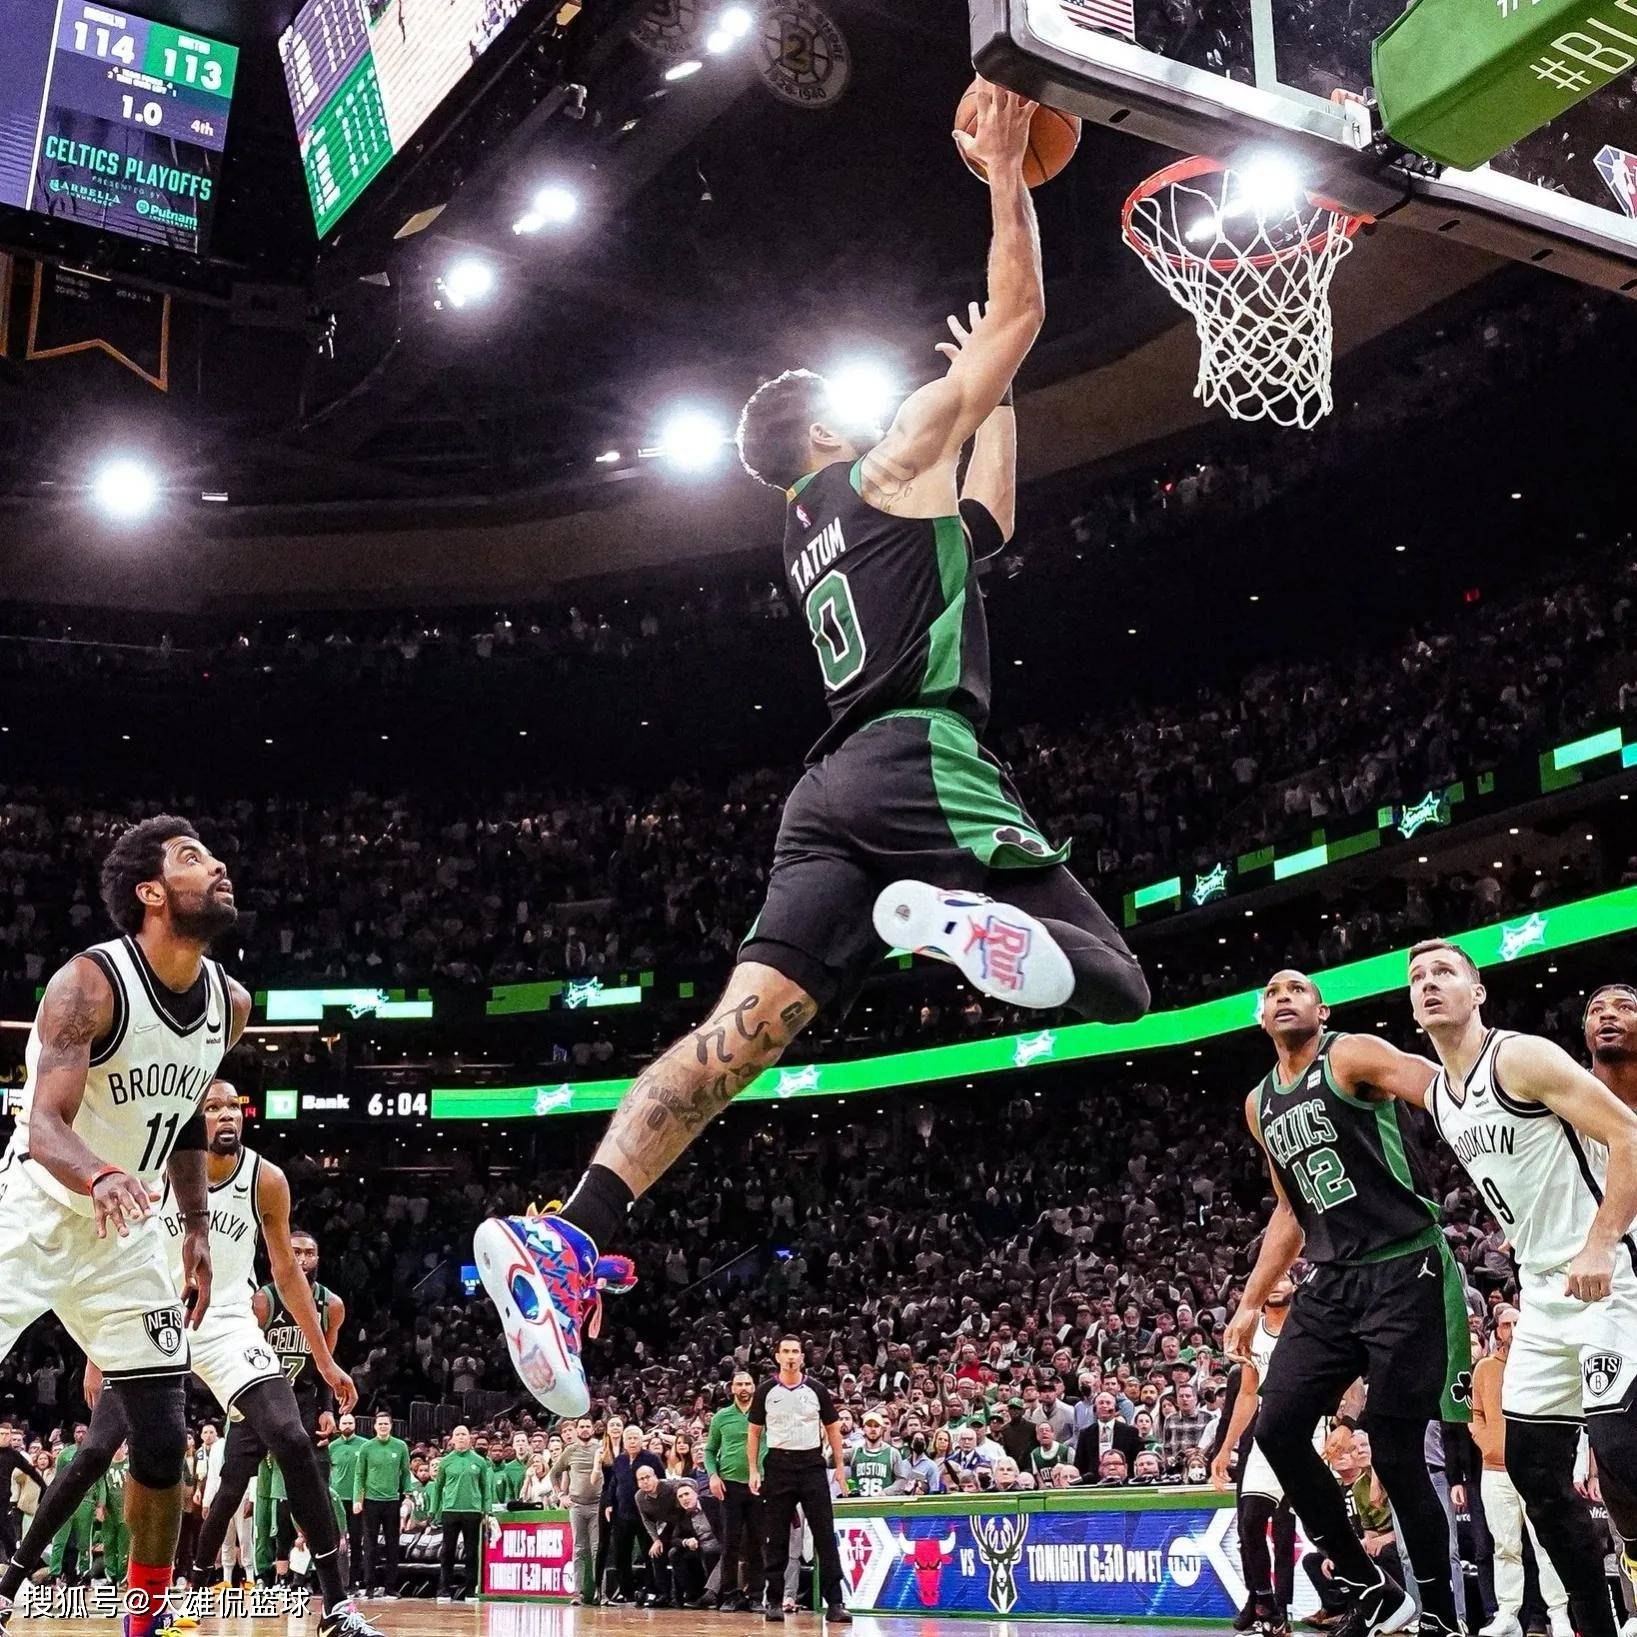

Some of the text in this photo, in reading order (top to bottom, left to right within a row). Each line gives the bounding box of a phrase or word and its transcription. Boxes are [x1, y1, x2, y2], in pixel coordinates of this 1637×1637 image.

[74, 21, 135, 64] 114
[164, 48, 222, 90] 113
[122, 95, 163, 126] 1.0
[190, 119, 214, 137] 4th
[45, 135, 212, 200] CELTICS PLAYOFFS
[150, 204, 197, 227] Putnam
[791, 517, 846, 594] TATUM
[806, 569, 867, 691] 0
[107, 1063, 211, 1105] BROOKLY
[302, 1094, 350, 1109] Bank
[368, 1093, 428, 1116] 6:04
[138, 1113, 180, 1171] 11
[1264, 1098, 1338, 1169] CELTICS
[1454, 1124, 1515, 1170] ROOKLYN
[1291, 1147, 1358, 1214] 42
[1482, 1177, 1515, 1225] 9
[164, 1210, 249, 1242] BKLYN
[147, 1310, 182, 1332] NETS
[165, 1331, 173, 1347] B
[267, 1326, 313, 1354] CELTI
[281, 1356, 306, 1386] 7
[1584, 1356, 1618, 1377] NETS
[856, 1462, 887, 1478] BOSTON
[858, 1477, 883, 1497] 36
[960, 1543, 1162, 1583] VS TONIGHT 6:30 PM ET
